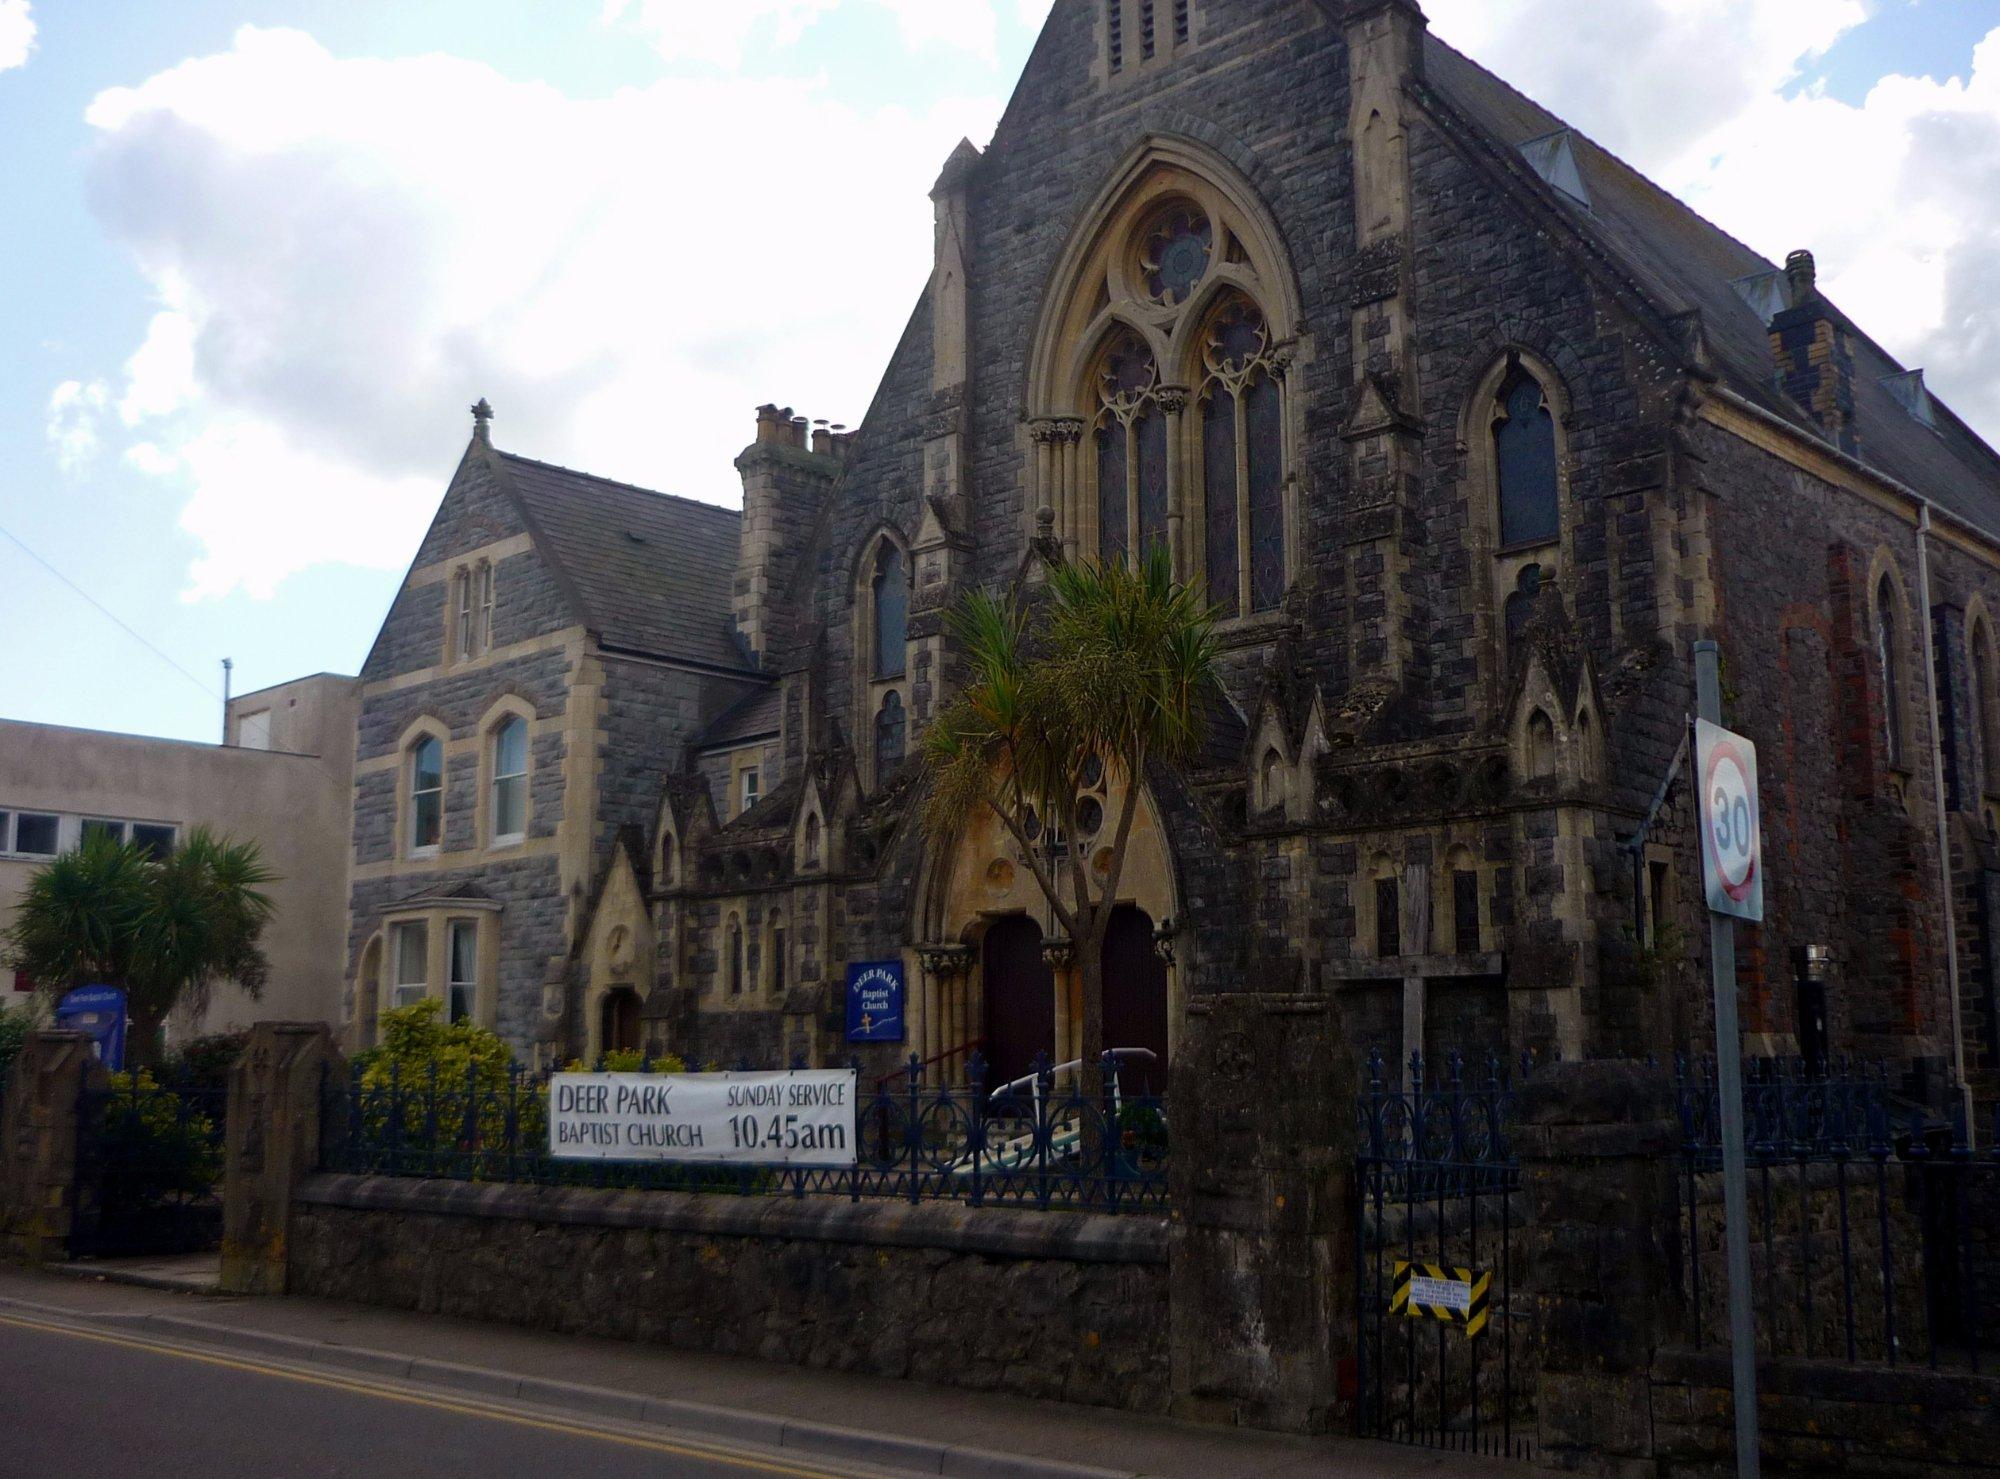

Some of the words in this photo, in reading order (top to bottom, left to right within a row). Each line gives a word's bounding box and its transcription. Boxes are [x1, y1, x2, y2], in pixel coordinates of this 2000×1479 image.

[1714, 786, 1748, 857] 30
[853, 969, 875, 992] DEER
[876, 968, 898, 990] PARK
[862, 988, 889, 1001] Baptist
[862, 1000, 889, 1010] Church
[559, 1084, 609, 1114] DEER
[616, 1085, 673, 1115] PARK
[727, 1083, 785, 1108] SUNDAY
[788, 1082, 846, 1106] SERVICE
[558, 1120, 621, 1146] BAPTIST
[627, 1122, 704, 1148] CHURCH
[728, 1113, 846, 1150] 10.45am
